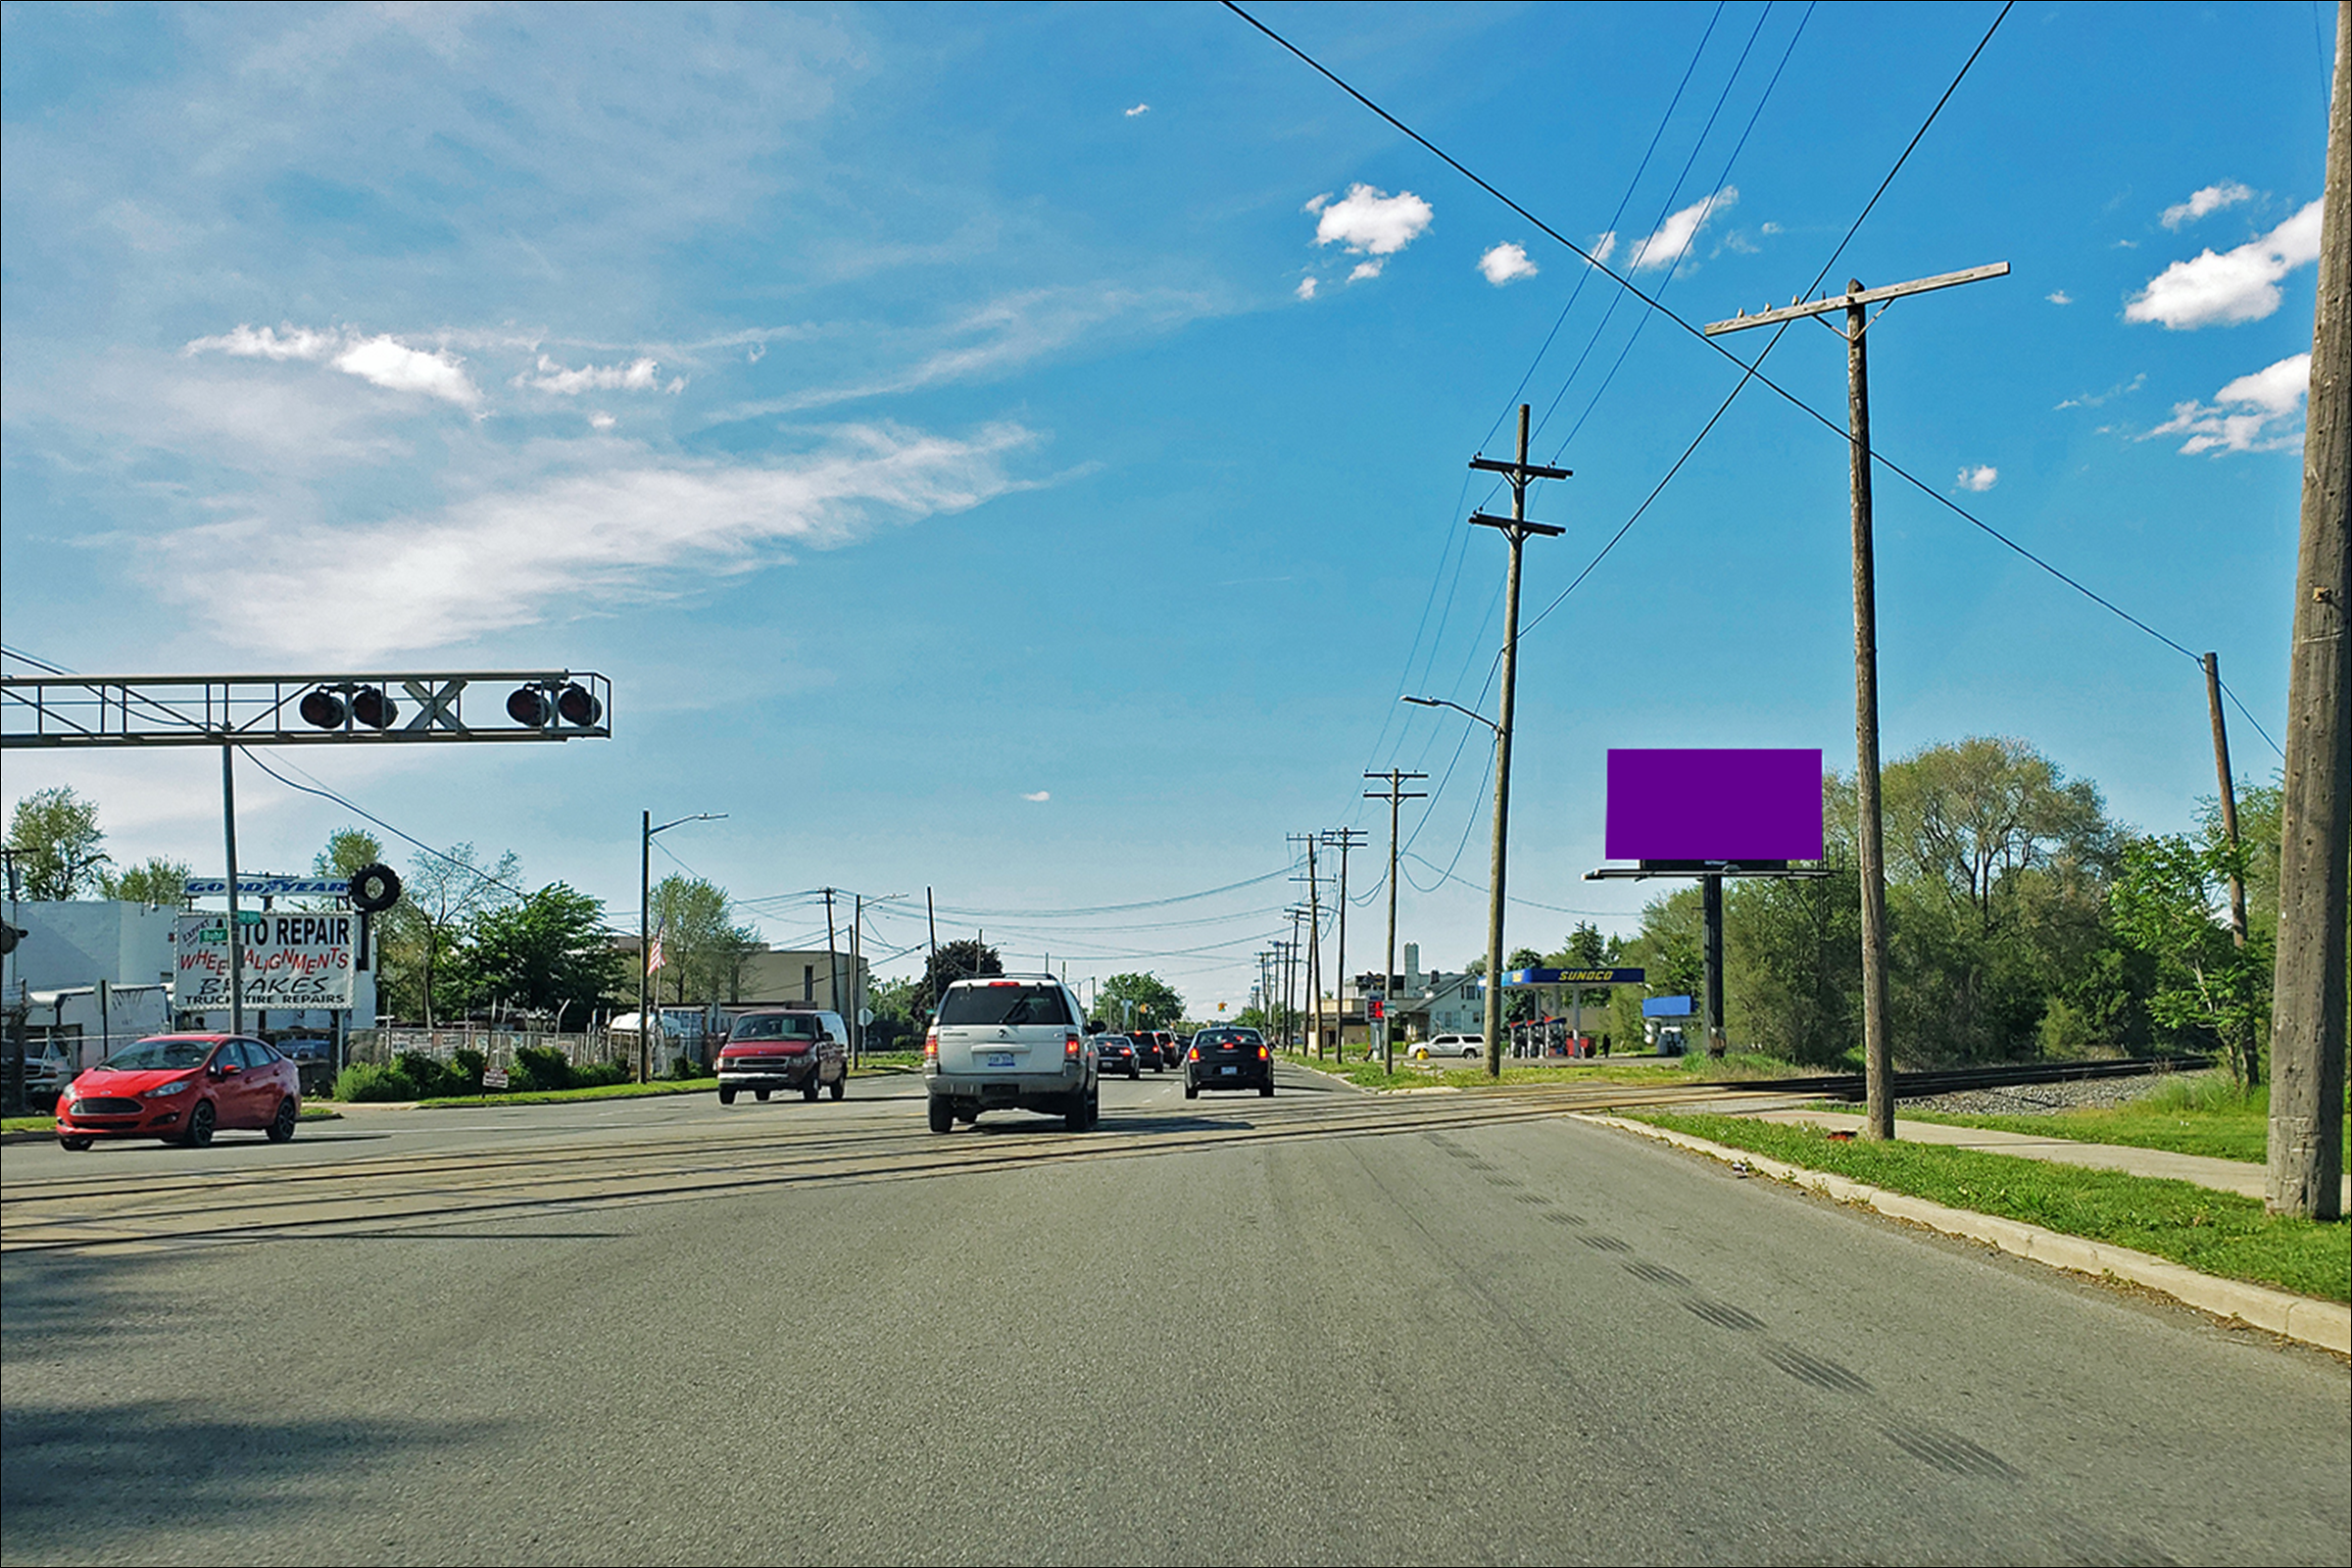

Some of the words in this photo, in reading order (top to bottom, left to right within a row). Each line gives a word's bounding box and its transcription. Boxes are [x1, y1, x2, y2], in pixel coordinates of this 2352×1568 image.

[210, 918, 269, 946] TO
[276, 918, 350, 946] REPAIR
[180, 949, 231, 975] WHEE
[245, 948, 349, 975] ALIGNMENTS
[1558, 970, 1613, 981] SUNOCO
[244, 995, 274, 1004] TIRE
[282, 994, 345, 1004] REPAIRS
